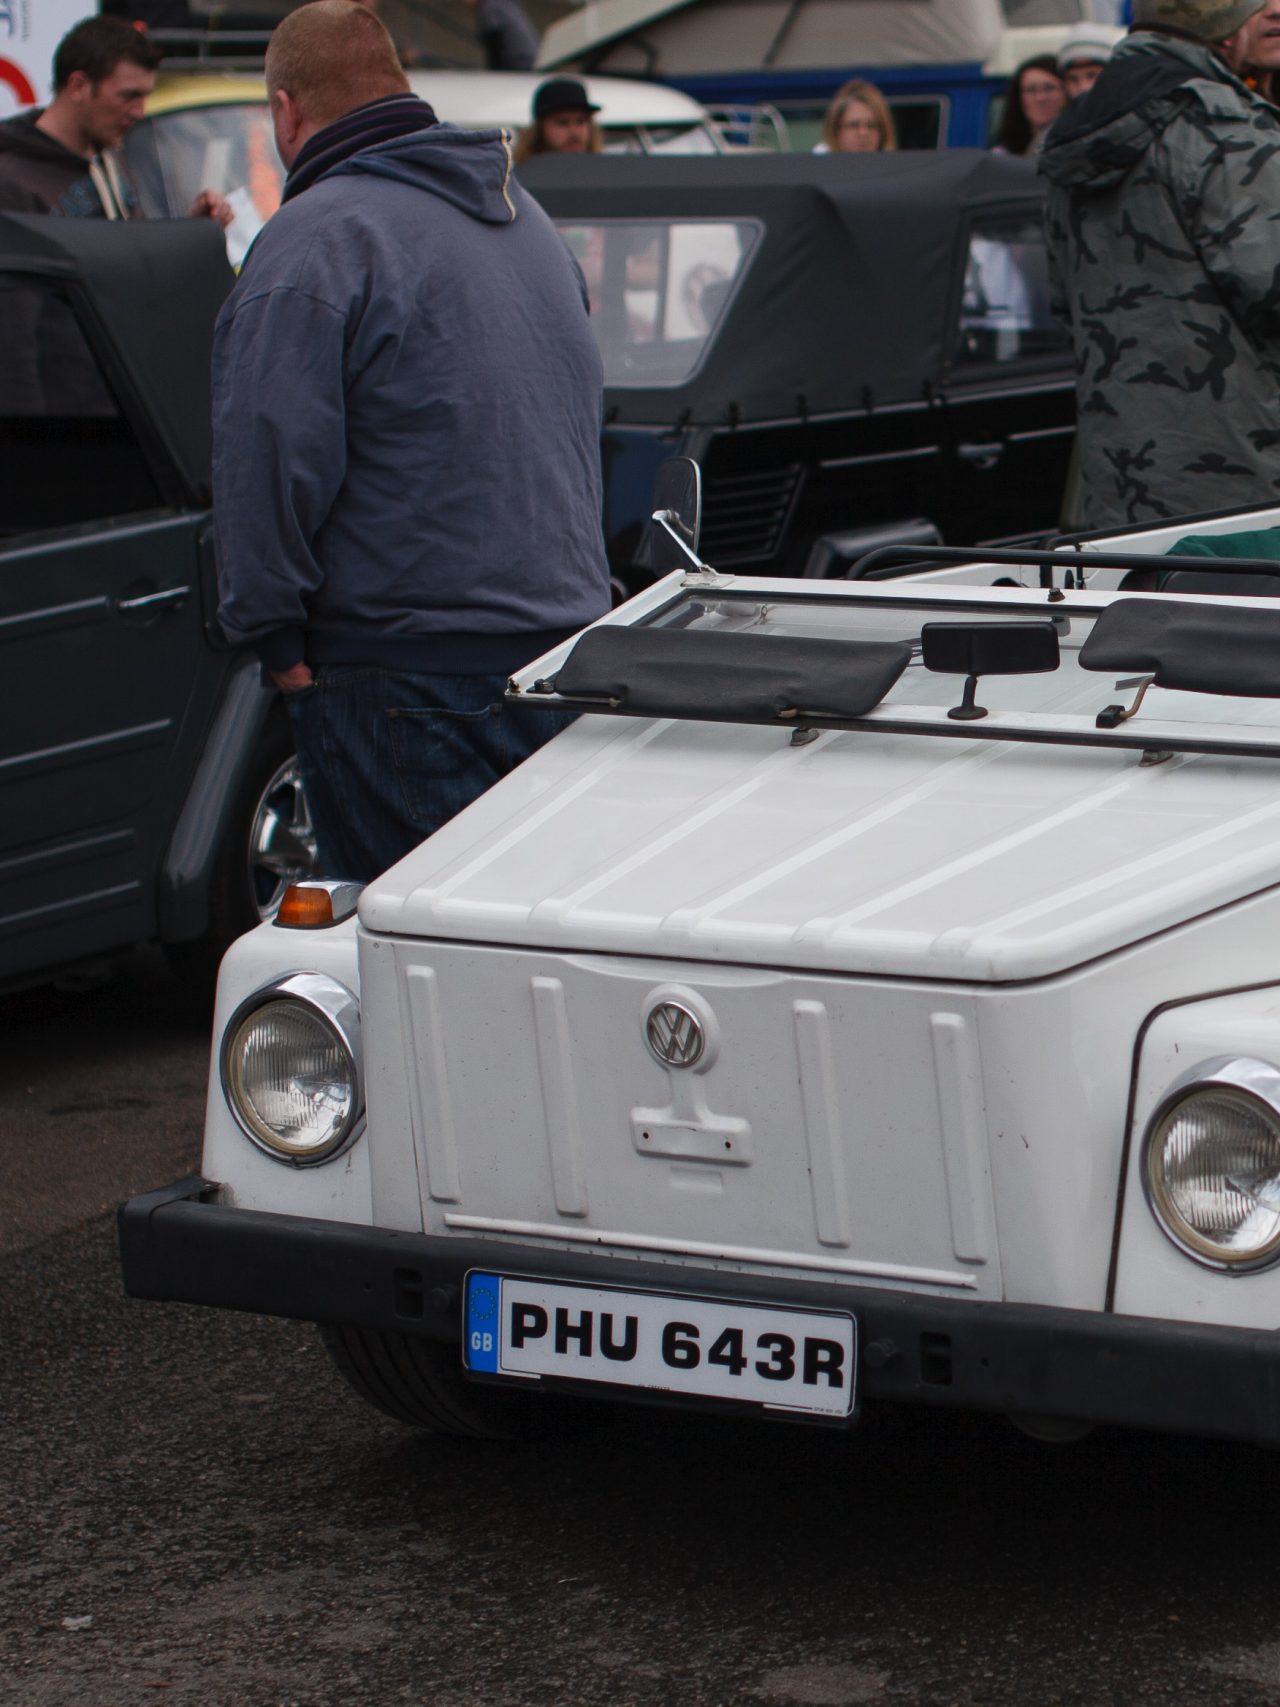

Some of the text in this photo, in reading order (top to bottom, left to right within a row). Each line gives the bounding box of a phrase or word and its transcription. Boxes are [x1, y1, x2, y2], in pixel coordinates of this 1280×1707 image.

[647, 1001, 705, 1069] VW
[471, 1331, 493, 1352] GB
[511, 1302, 845, 1388] PHU 643R
